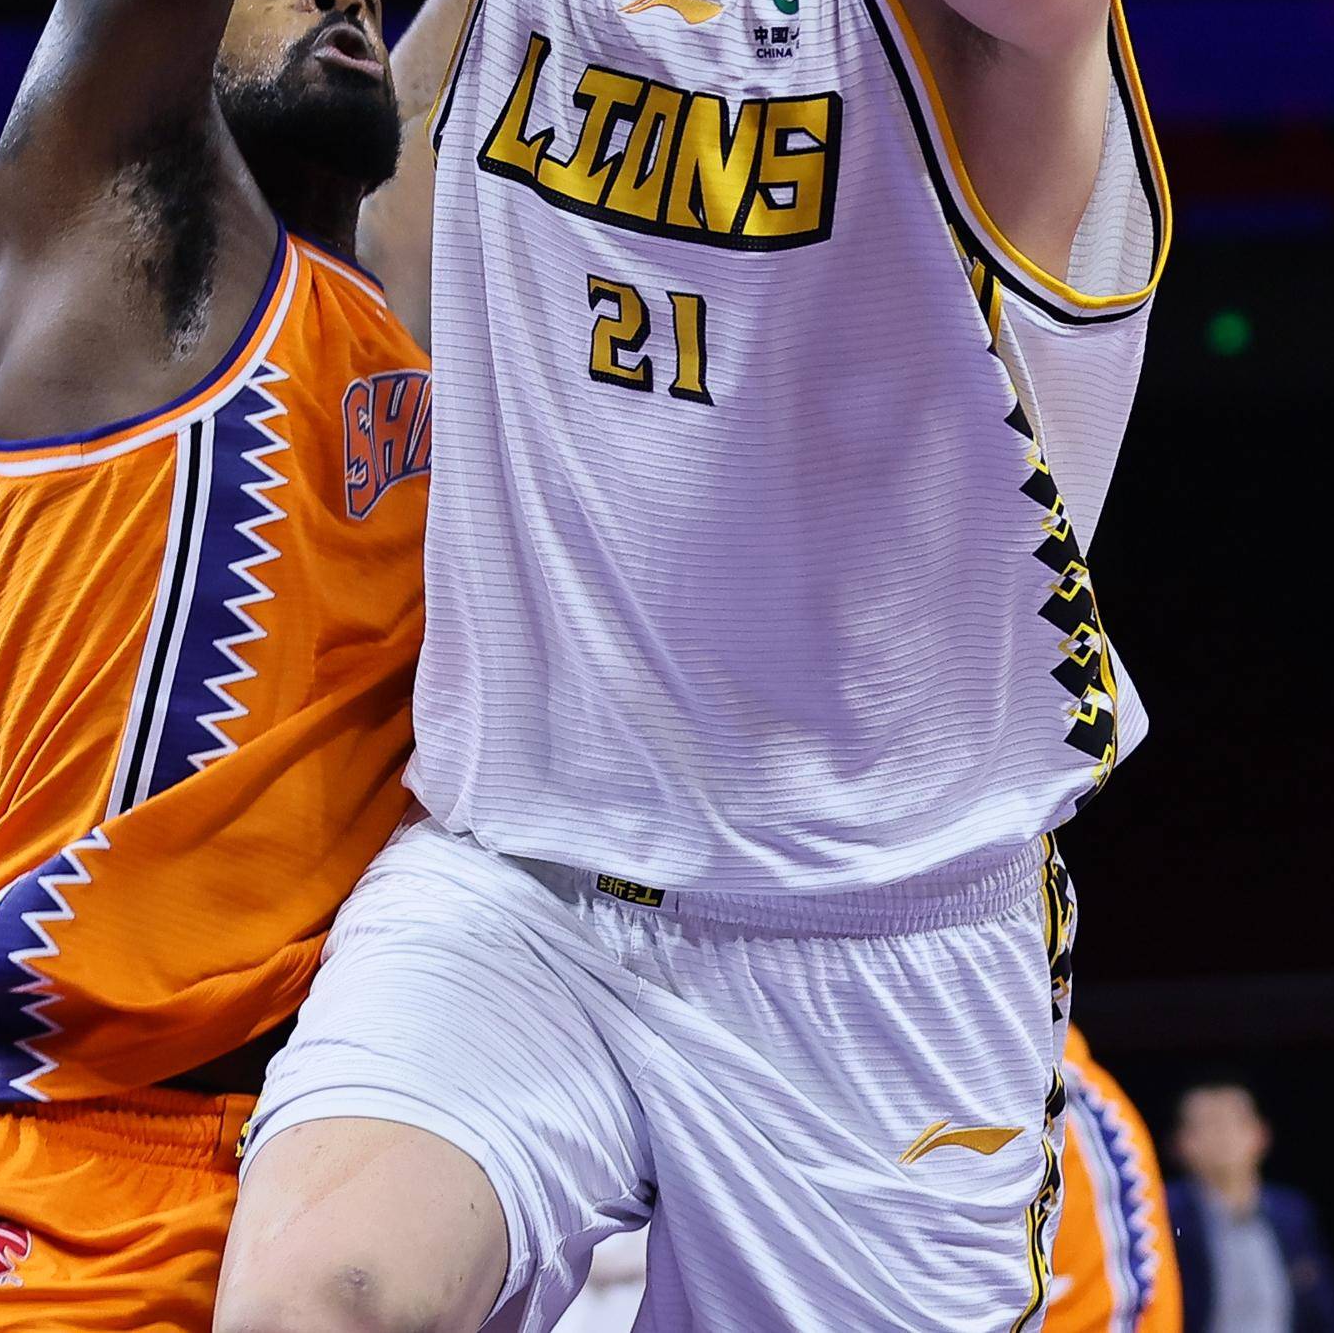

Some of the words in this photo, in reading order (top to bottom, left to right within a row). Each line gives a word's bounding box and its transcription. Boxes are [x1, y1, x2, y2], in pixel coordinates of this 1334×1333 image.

[756, 47, 793, 59] CHINA
[477, 31, 843, 252] LIONS
[586, 273, 715, 406] 21
[598, 874, 662, 907] 浙江
